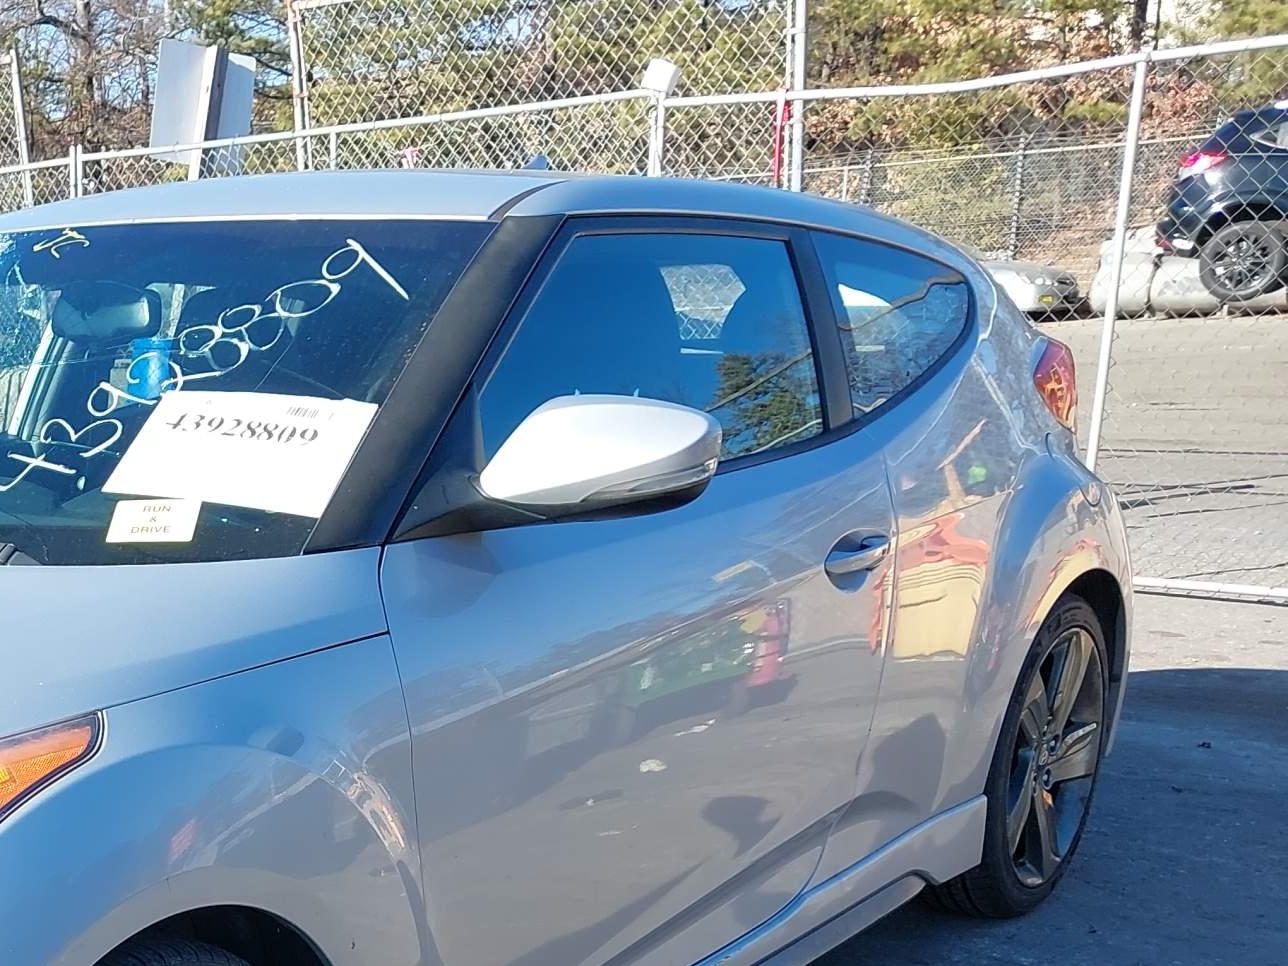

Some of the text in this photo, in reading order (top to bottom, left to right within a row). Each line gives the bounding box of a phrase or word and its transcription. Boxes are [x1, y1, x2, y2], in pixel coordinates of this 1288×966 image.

[165, 412, 319, 446] 43928809
[142, 505, 172, 513] RUN
[130, 525, 171, 534] DRIVE
